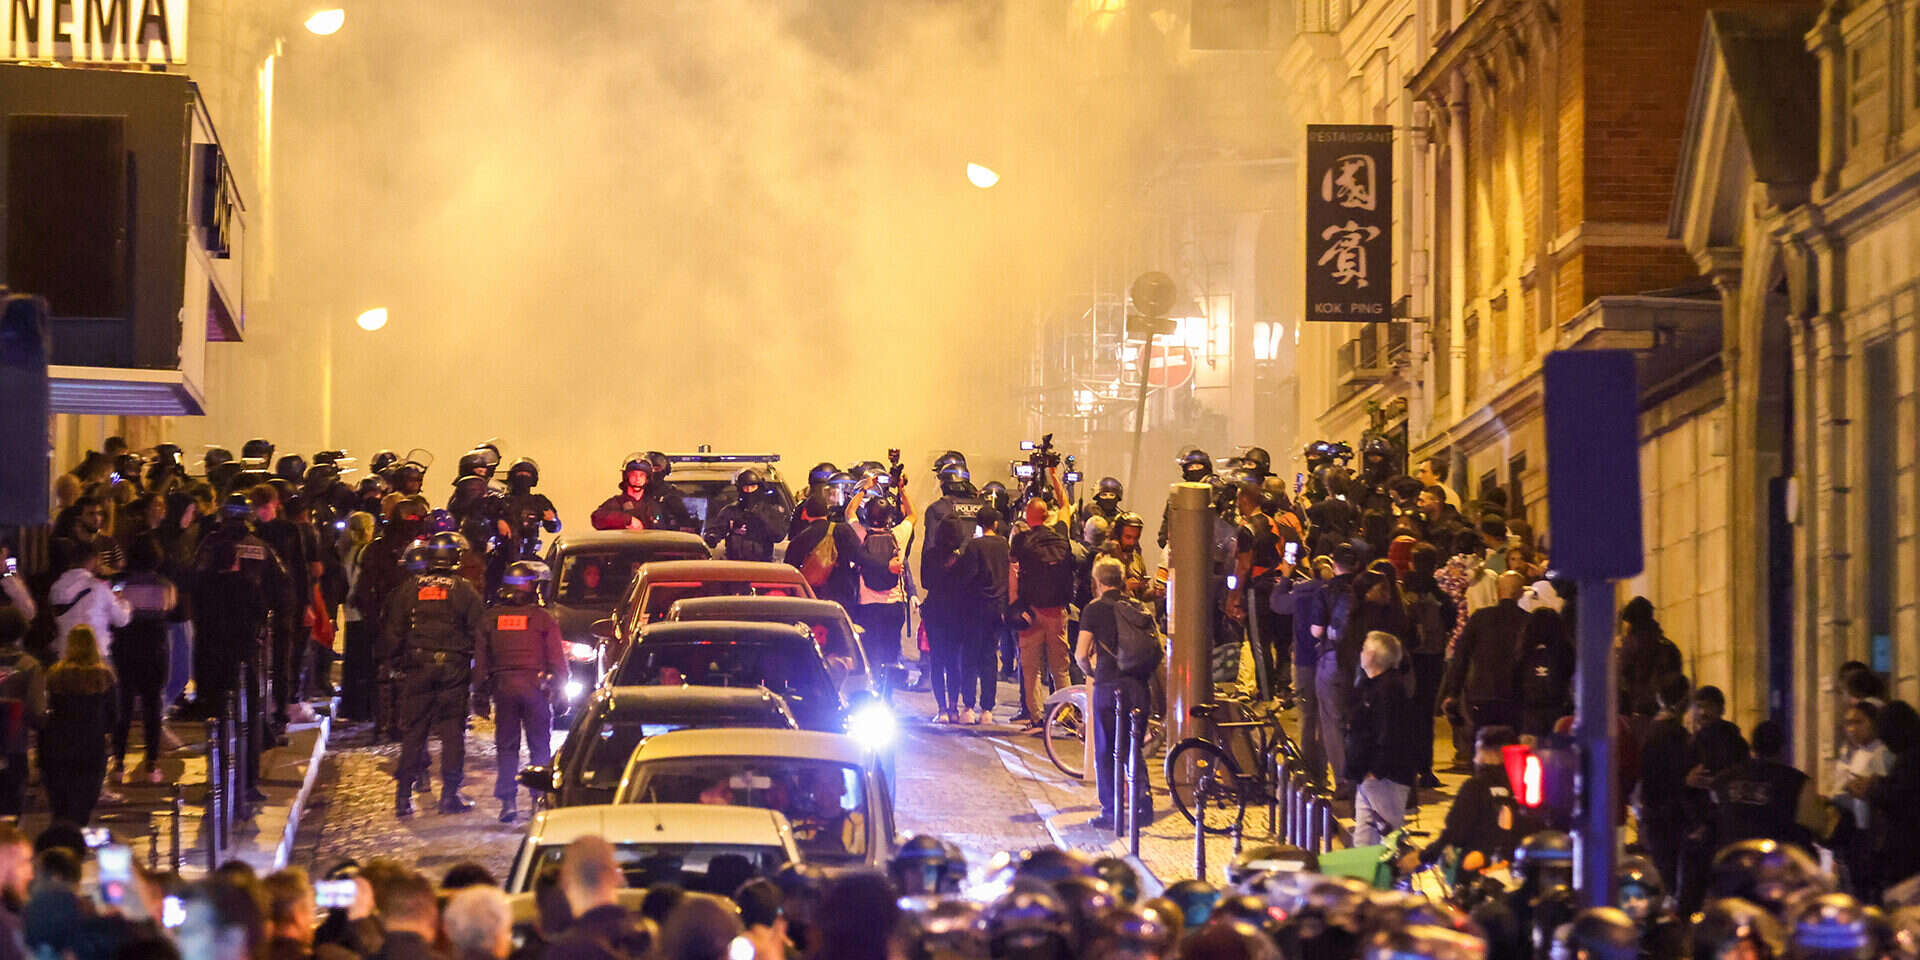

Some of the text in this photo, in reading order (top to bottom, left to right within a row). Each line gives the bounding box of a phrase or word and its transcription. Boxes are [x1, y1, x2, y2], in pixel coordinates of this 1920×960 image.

[1315, 303, 1383, 314] KOK PING
[418, 575, 454, 586] POLICE
